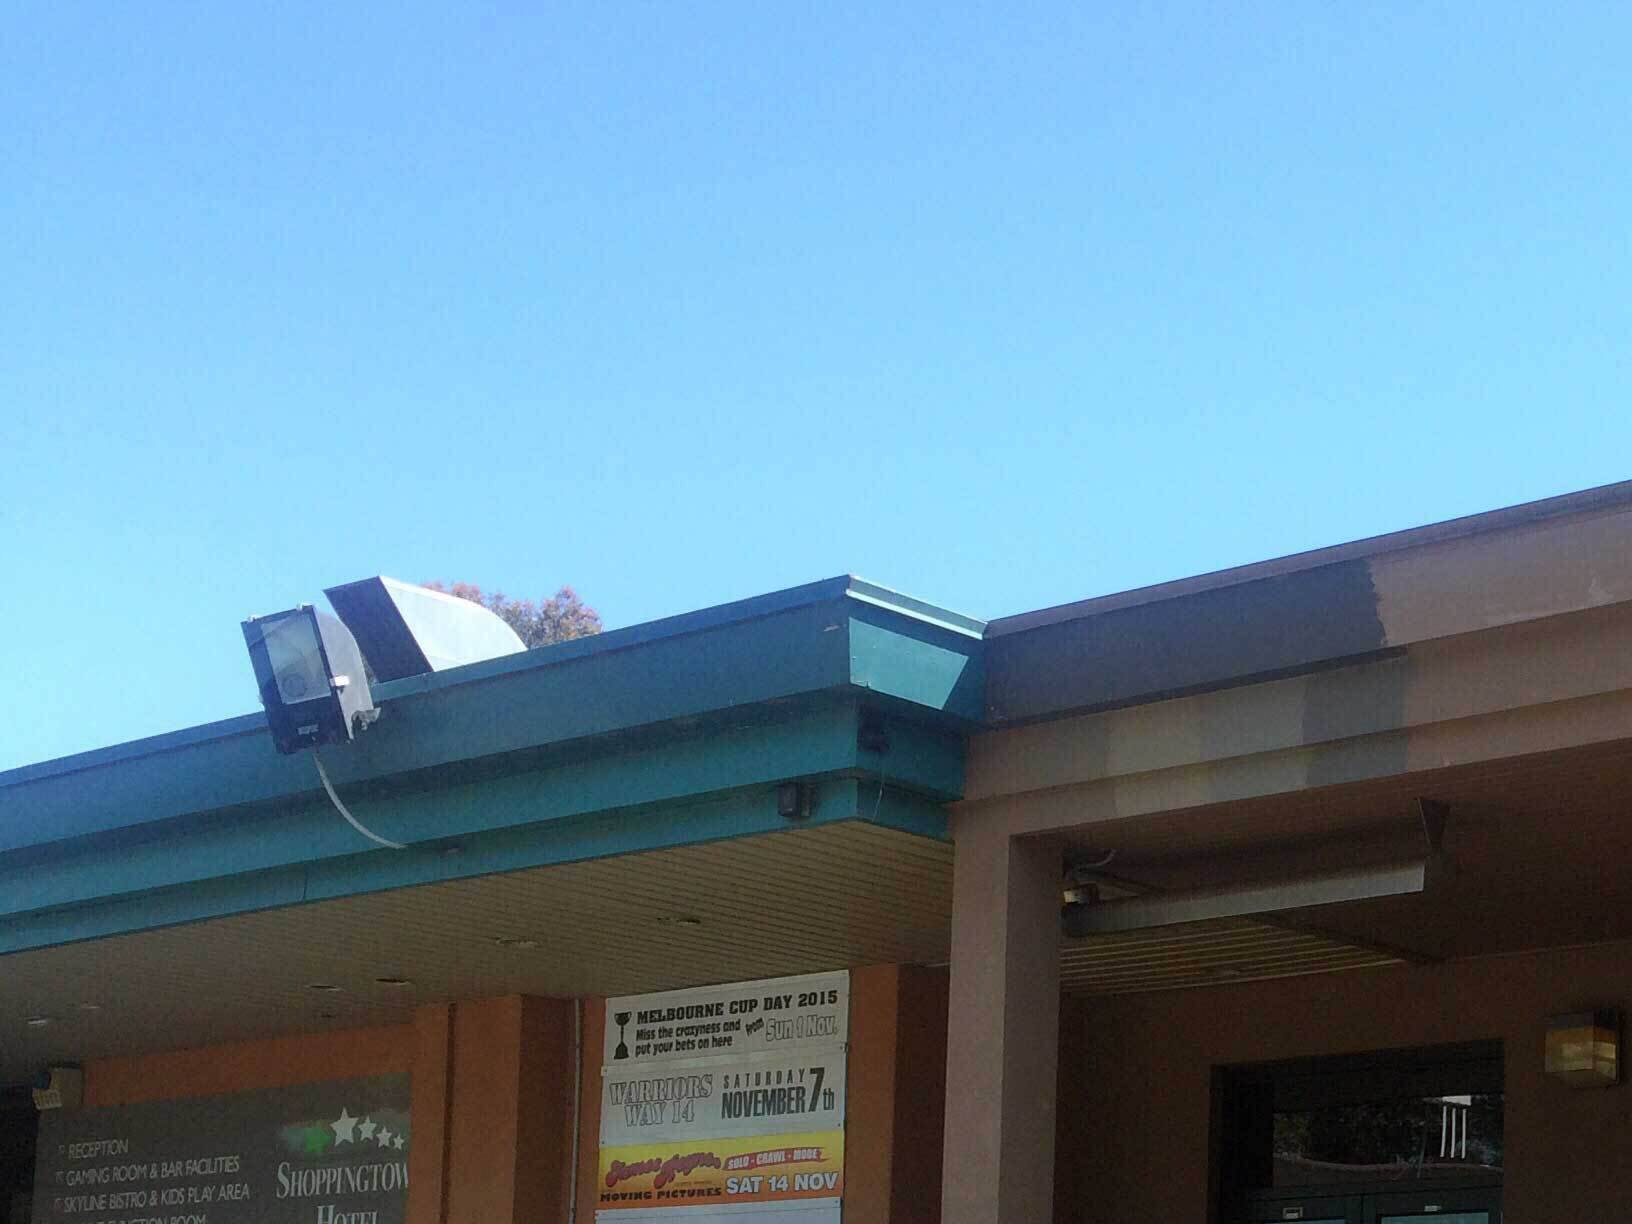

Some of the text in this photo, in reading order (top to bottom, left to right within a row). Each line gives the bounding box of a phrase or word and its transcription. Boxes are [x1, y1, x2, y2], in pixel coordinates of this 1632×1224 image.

[637, 990, 838, 1024] MELBOURNE CUP DAY 2015
[636, 1019, 741, 1041] Miss the crazyness and
[766, 1018, 793, 1041] Sun
[635, 1035, 732, 1057] put your bets on here
[609, 1074, 713, 1105] WARRIORS
[723, 1068, 806, 1089] SATURDAY
[722, 1086, 806, 1119] NOVEMBER
[624, 1101, 695, 1127] WAY 14
[68, 1138, 129, 1159] RECEPTION
[66, 1155, 240, 1186] GAMING ROOM & BAR FACILITIES
[728, 1155, 750, 1170] SOLO
[726, 1172, 839, 1194] SAT 14 NOV
[64, 1183, 250, 1213] SKYLINE BISTRO & KIDS PLAY AREA
[601, 1187, 721, 1202] MOVING PICTURES
